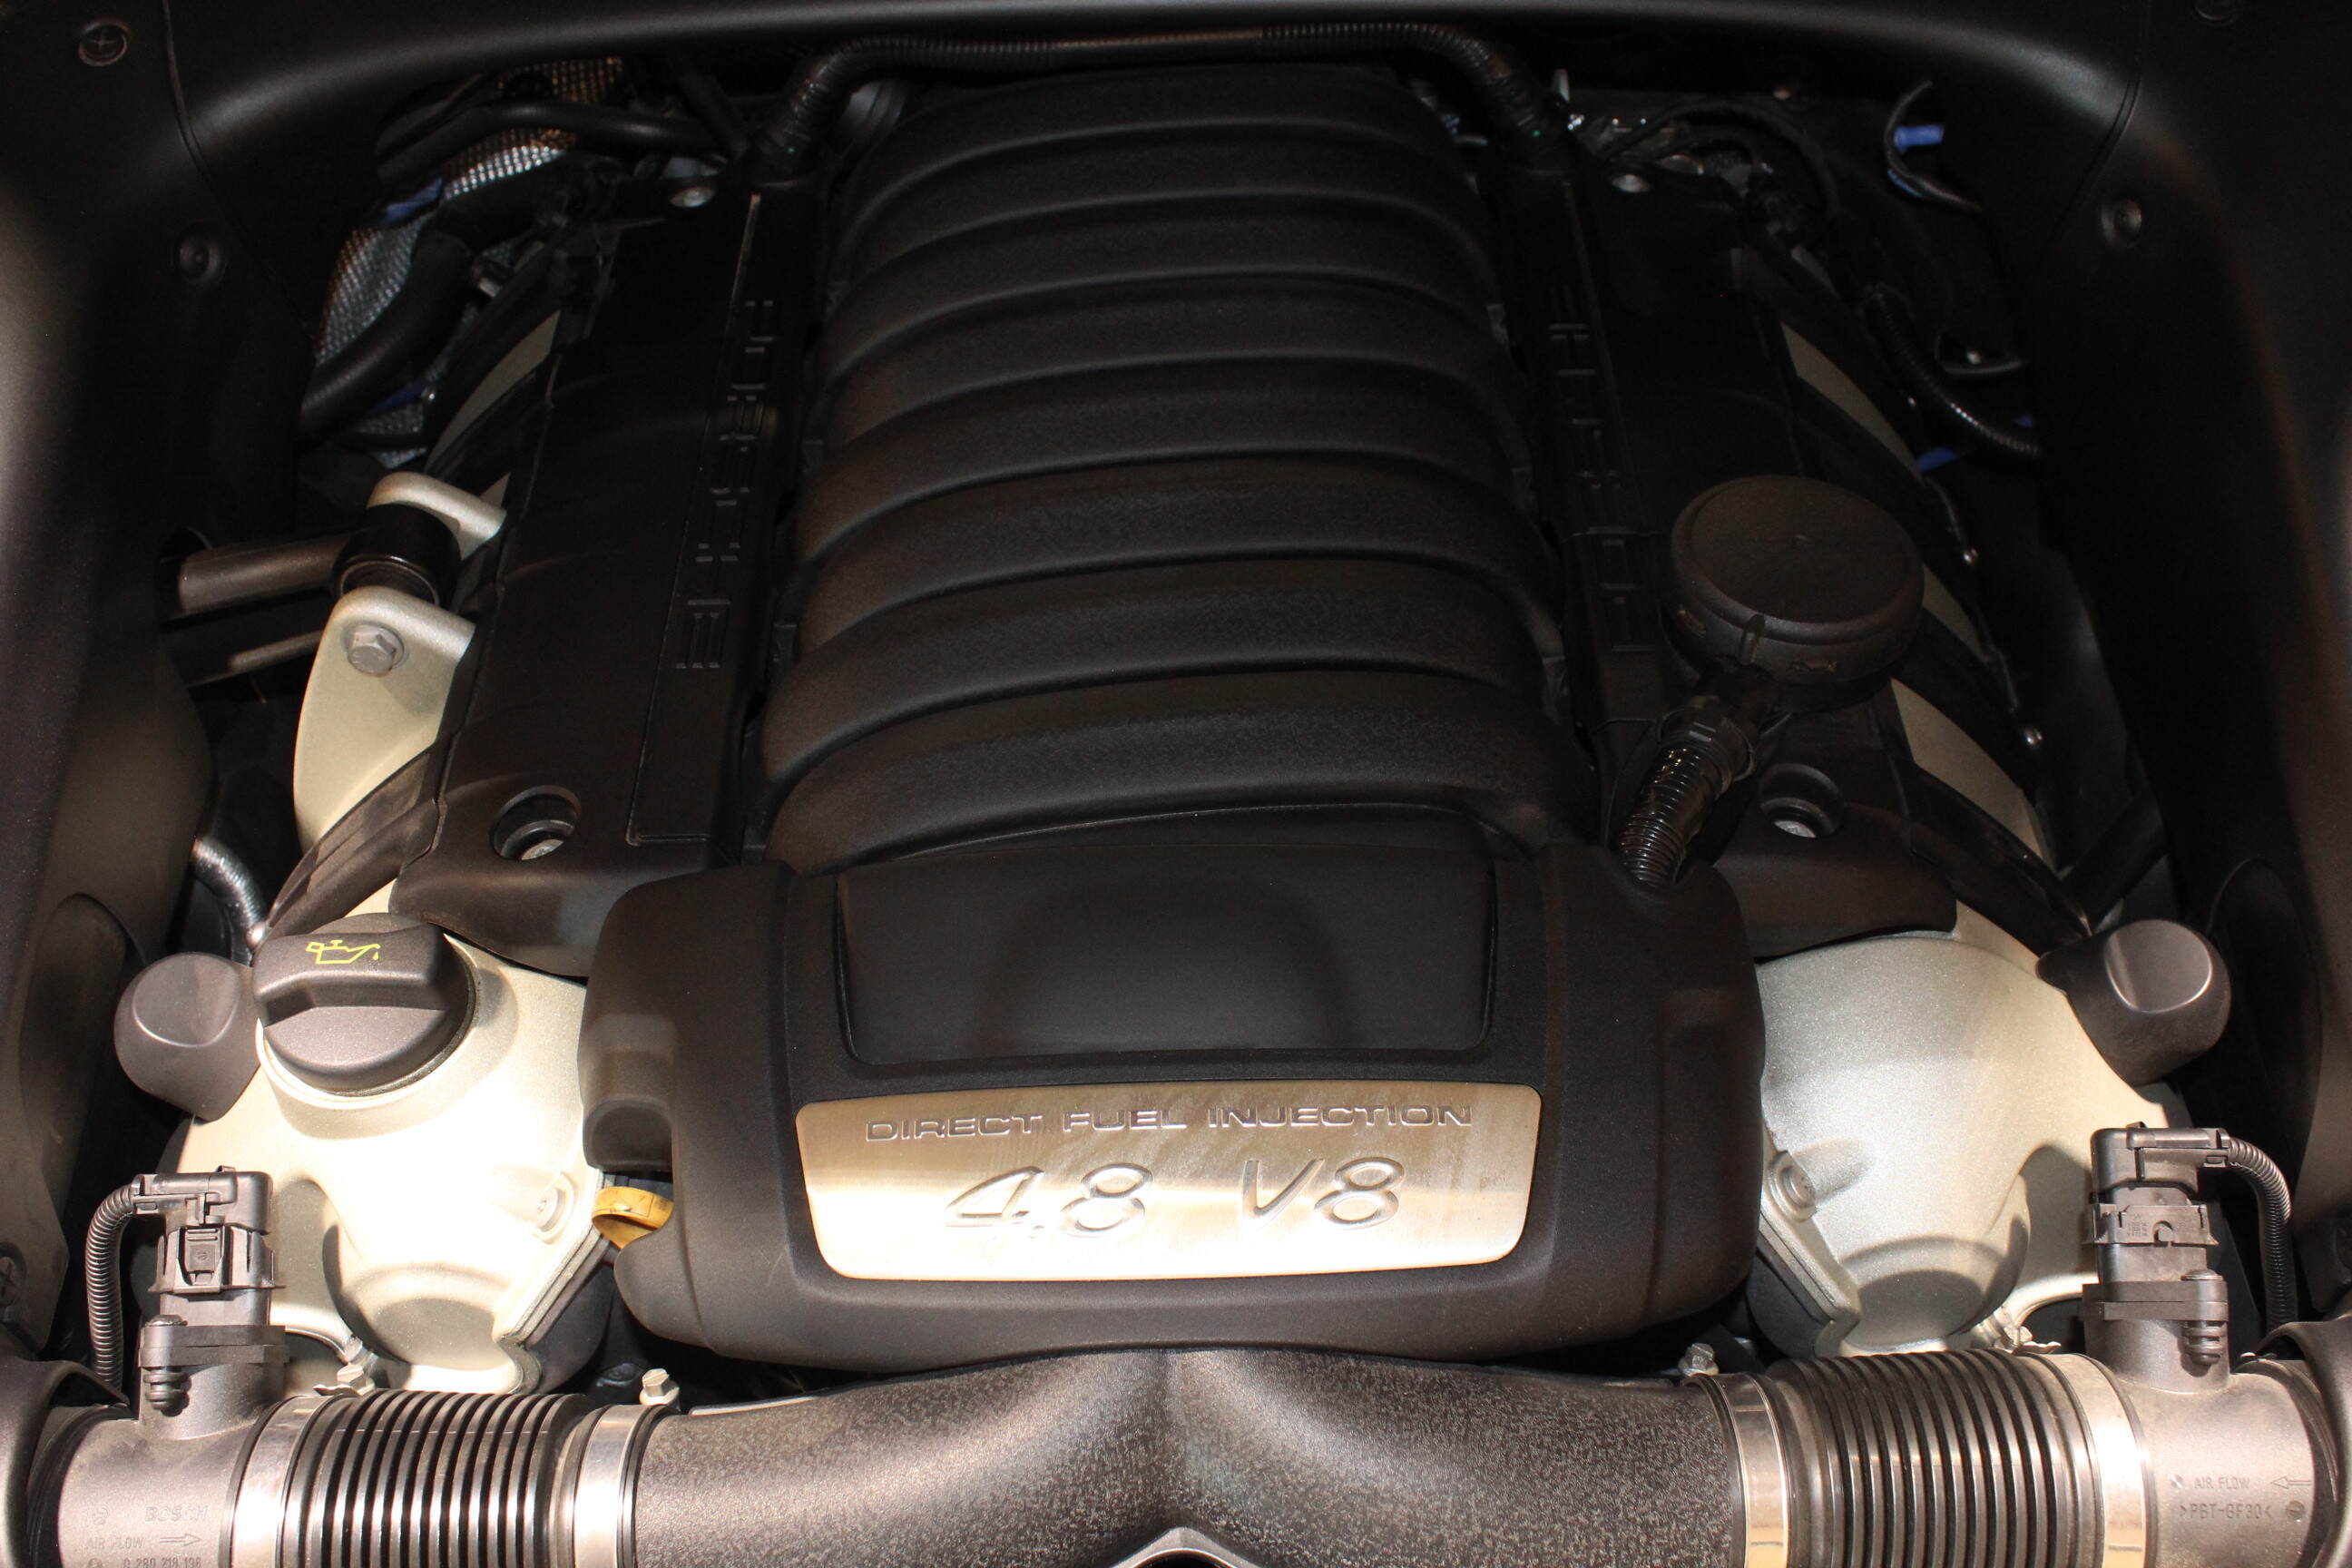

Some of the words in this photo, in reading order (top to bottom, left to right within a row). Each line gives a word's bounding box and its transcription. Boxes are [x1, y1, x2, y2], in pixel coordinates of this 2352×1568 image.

[866, 1115, 1043, 1142] DIRECT
[1063, 1109, 1187, 1132] FUEL
[1208, 1104, 1472, 1127] INJECTION
[1240, 1156, 1406, 1230] V8
[2194, 1476, 2214, 1489] AIR
[2219, 1475, 2250, 1489] FLOW
[145, 1504, 209, 1522] BOSCH
